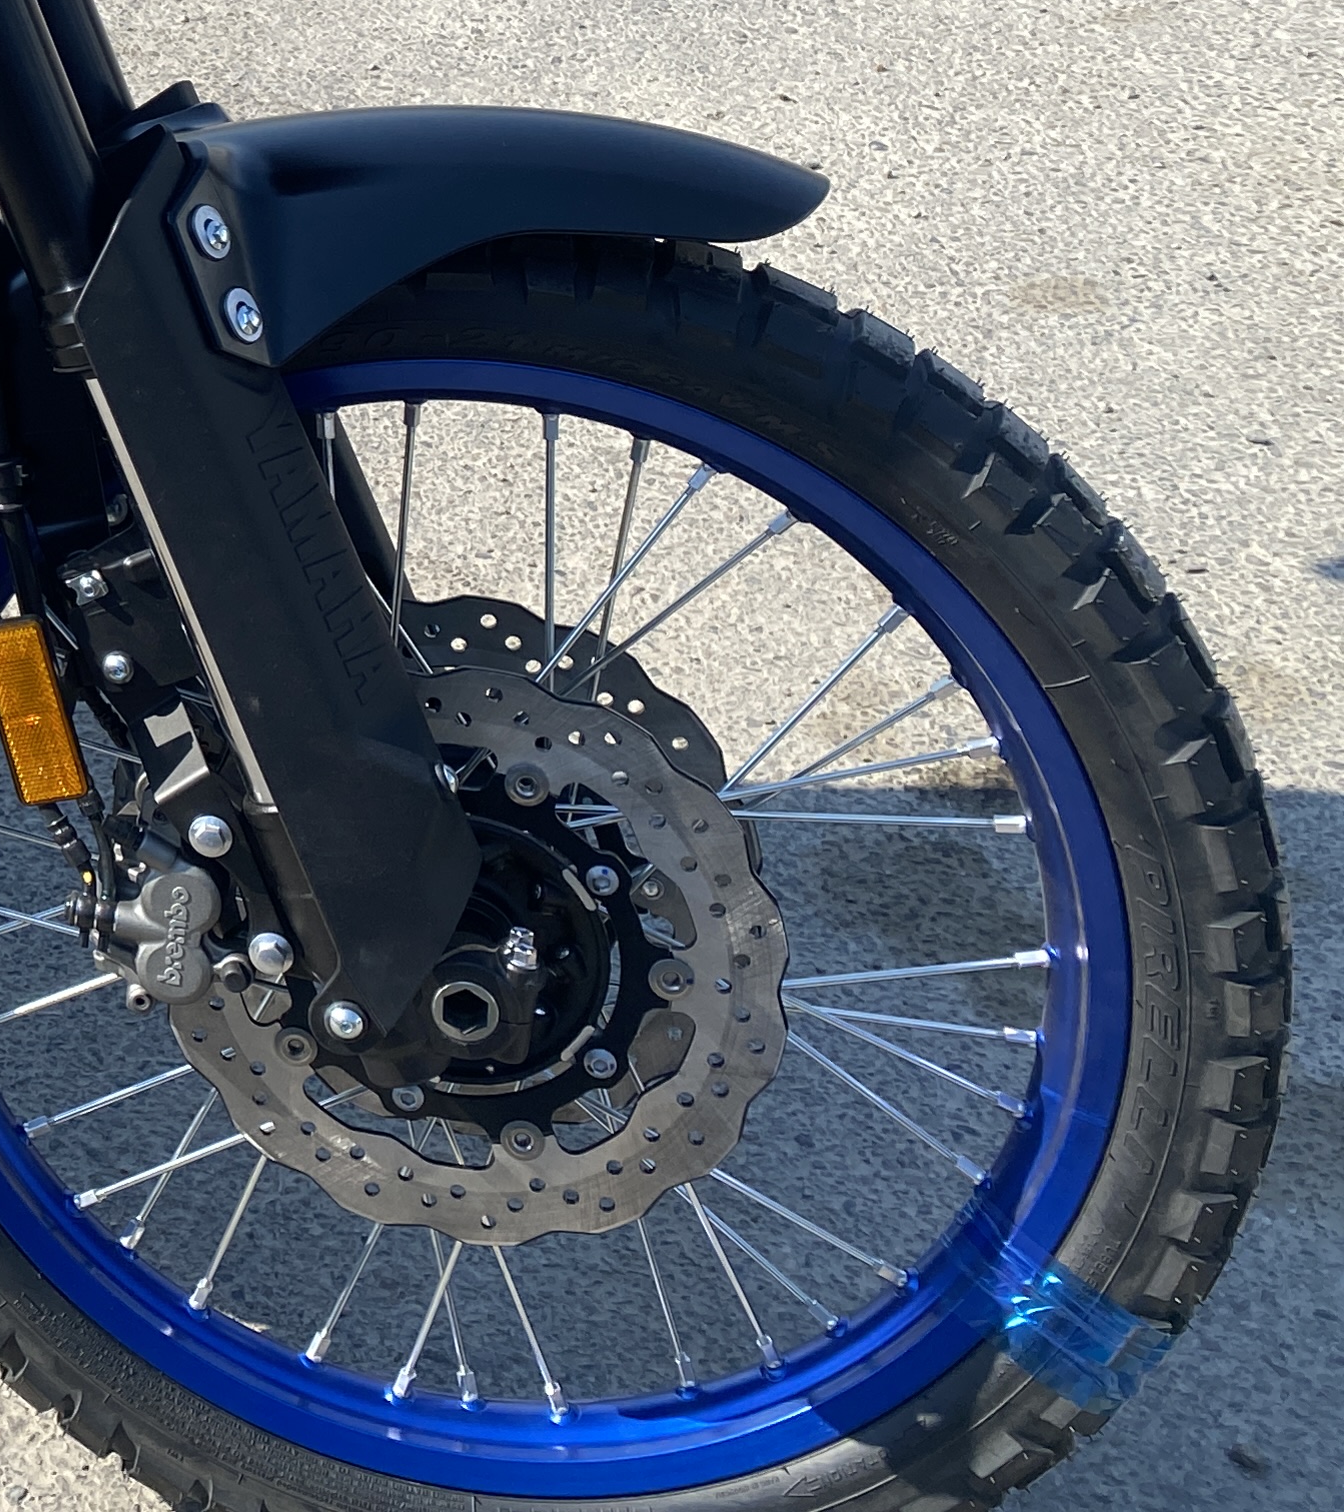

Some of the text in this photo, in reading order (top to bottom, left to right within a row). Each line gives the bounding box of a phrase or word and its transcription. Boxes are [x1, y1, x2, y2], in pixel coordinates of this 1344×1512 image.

[245, 393, 389, 707] YAMAHA
[156, 885, 193, 988] brembo
[1120, 838, 1184, 1176] PIRELLI
